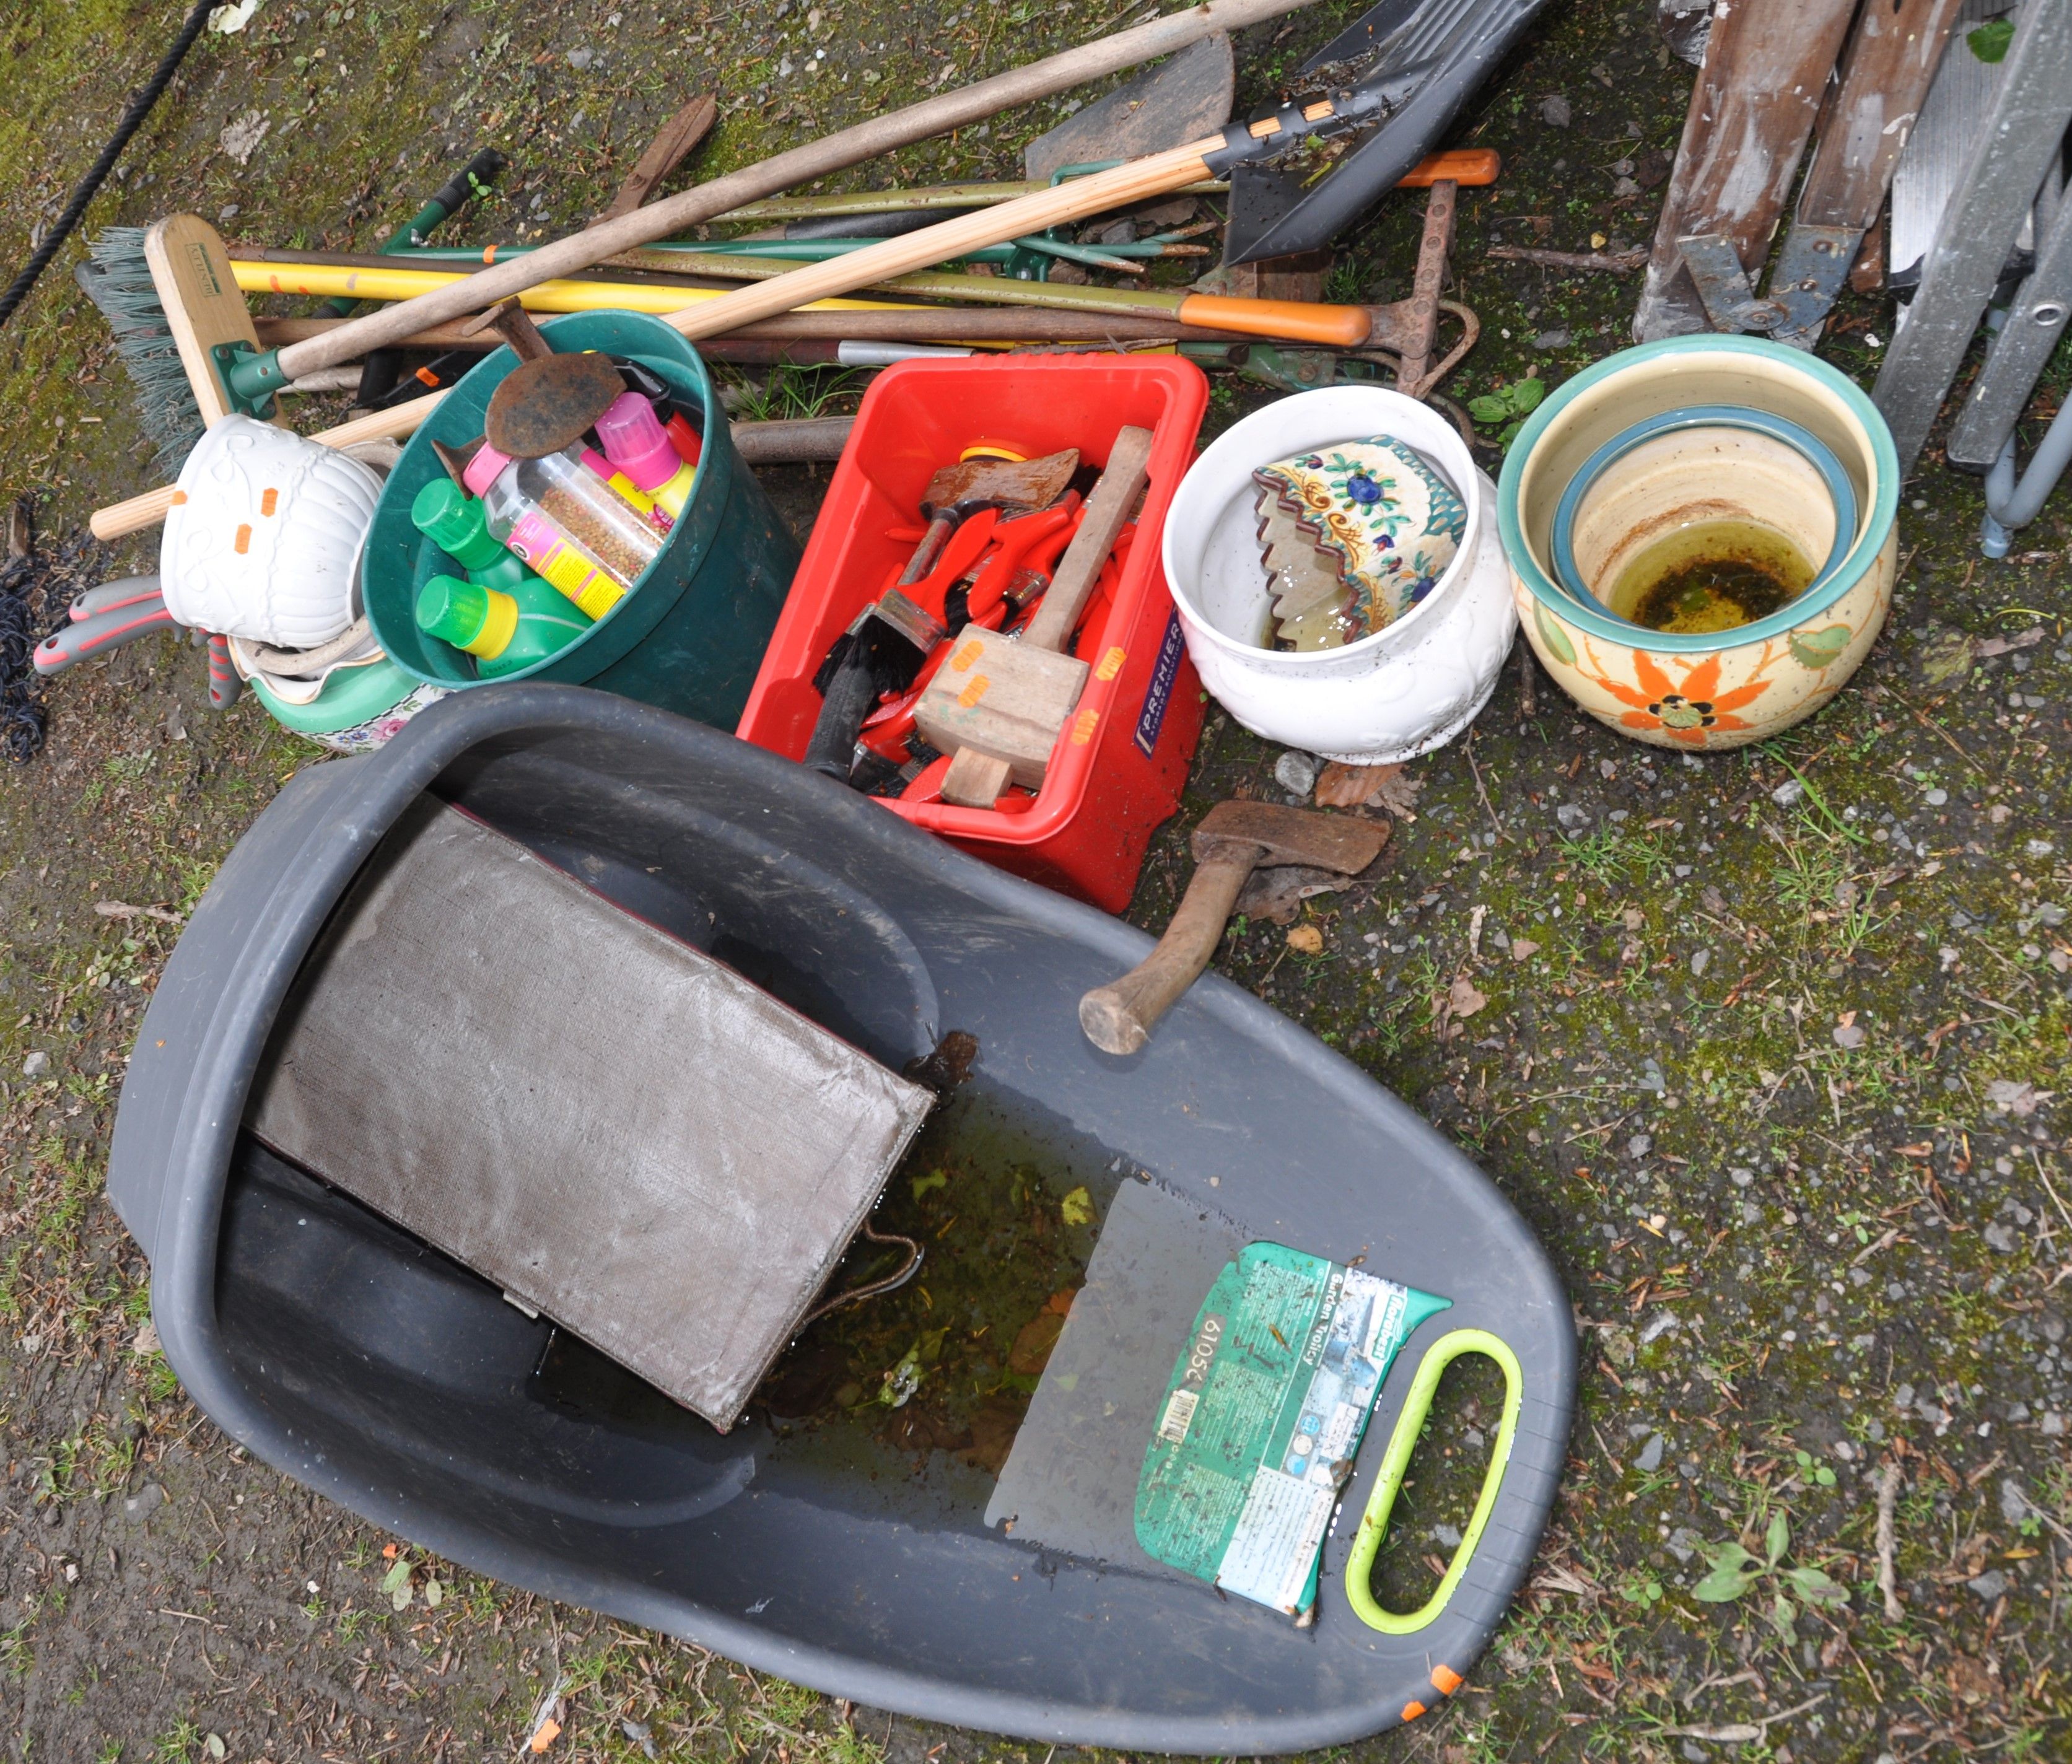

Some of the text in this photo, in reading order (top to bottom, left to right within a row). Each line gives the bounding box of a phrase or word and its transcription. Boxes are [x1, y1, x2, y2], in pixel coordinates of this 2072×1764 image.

[1141, 622, 1179, 730] PREMIER
[1301, 1272, 1344, 1365] Garden Trolley
[1373, 1295, 1404, 1358] florabest
